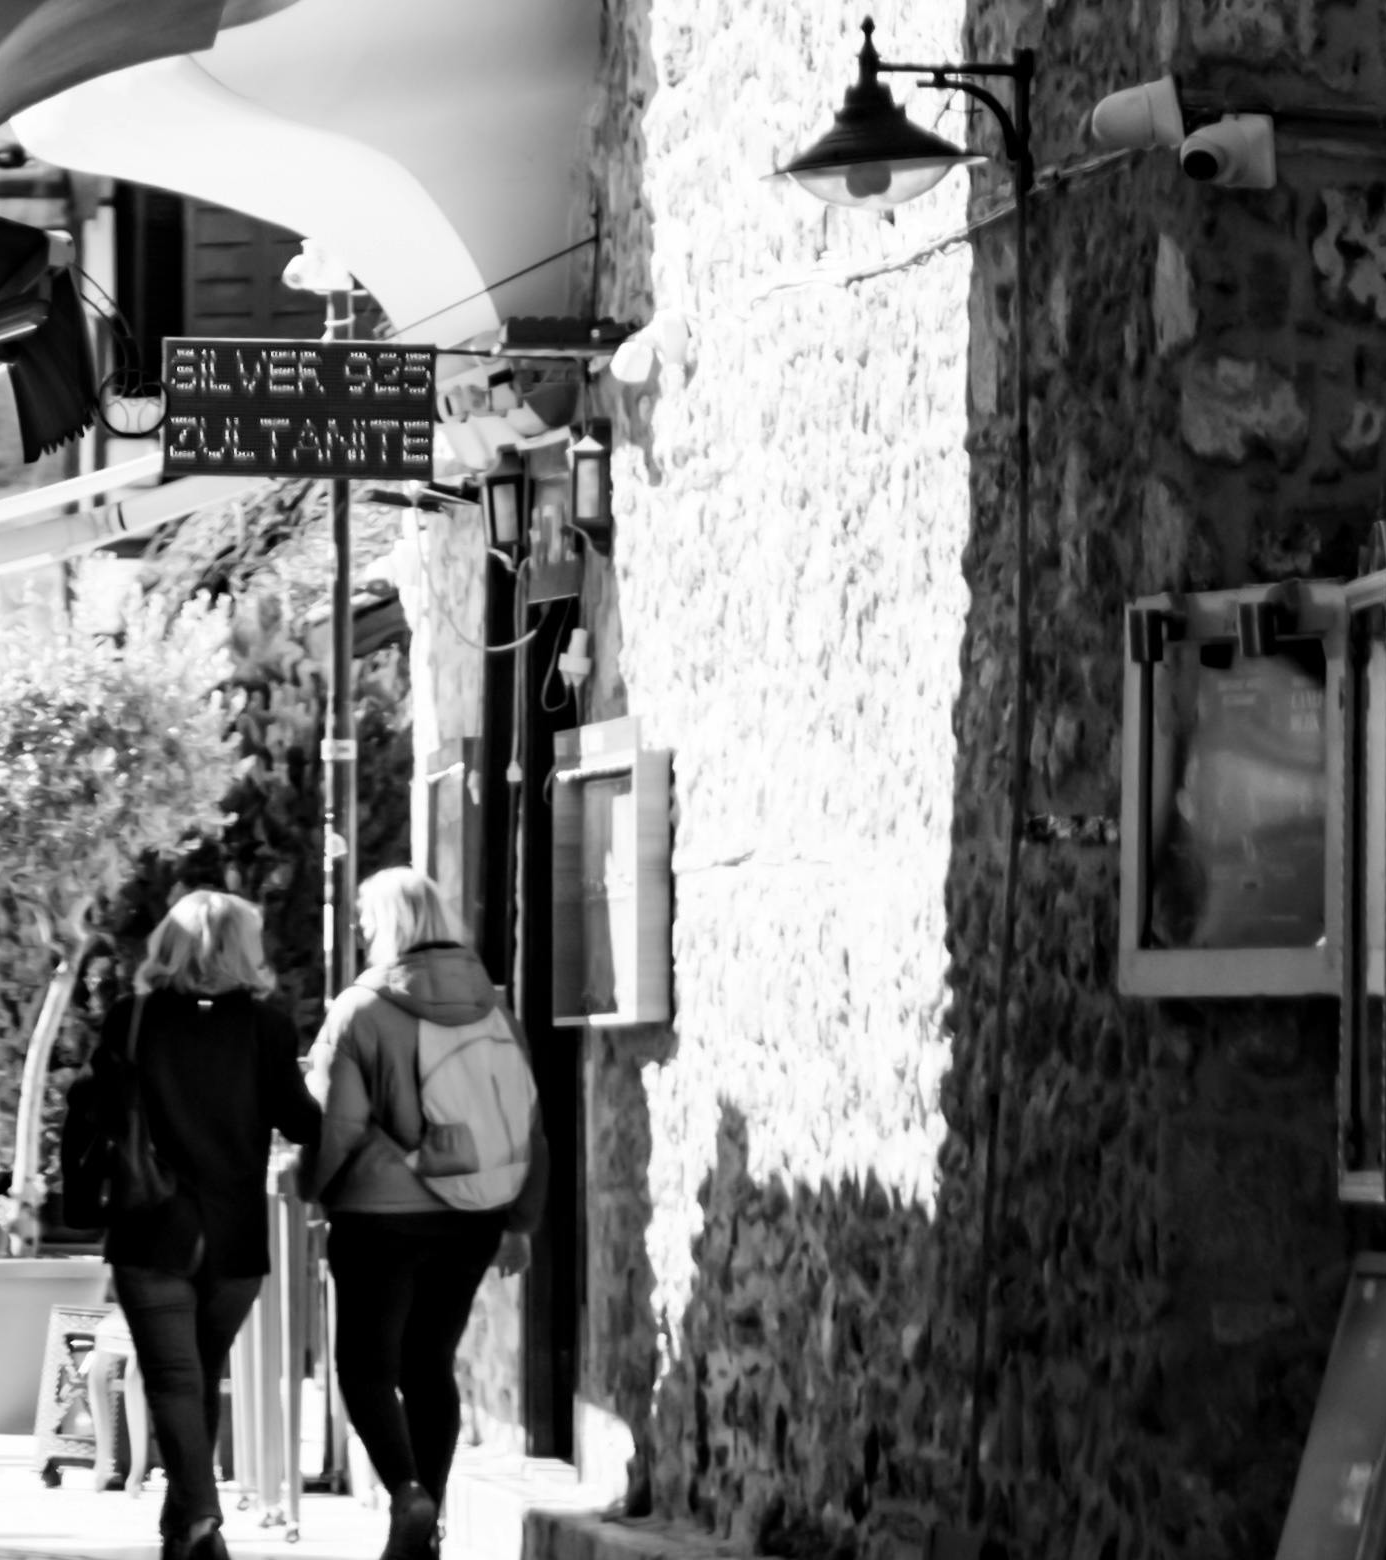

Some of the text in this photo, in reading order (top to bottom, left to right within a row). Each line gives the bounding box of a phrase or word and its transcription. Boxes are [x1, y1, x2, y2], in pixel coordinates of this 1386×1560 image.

[171, 347, 433, 397] SILVER 925
[169, 415, 430, 464] ZULTANITE
